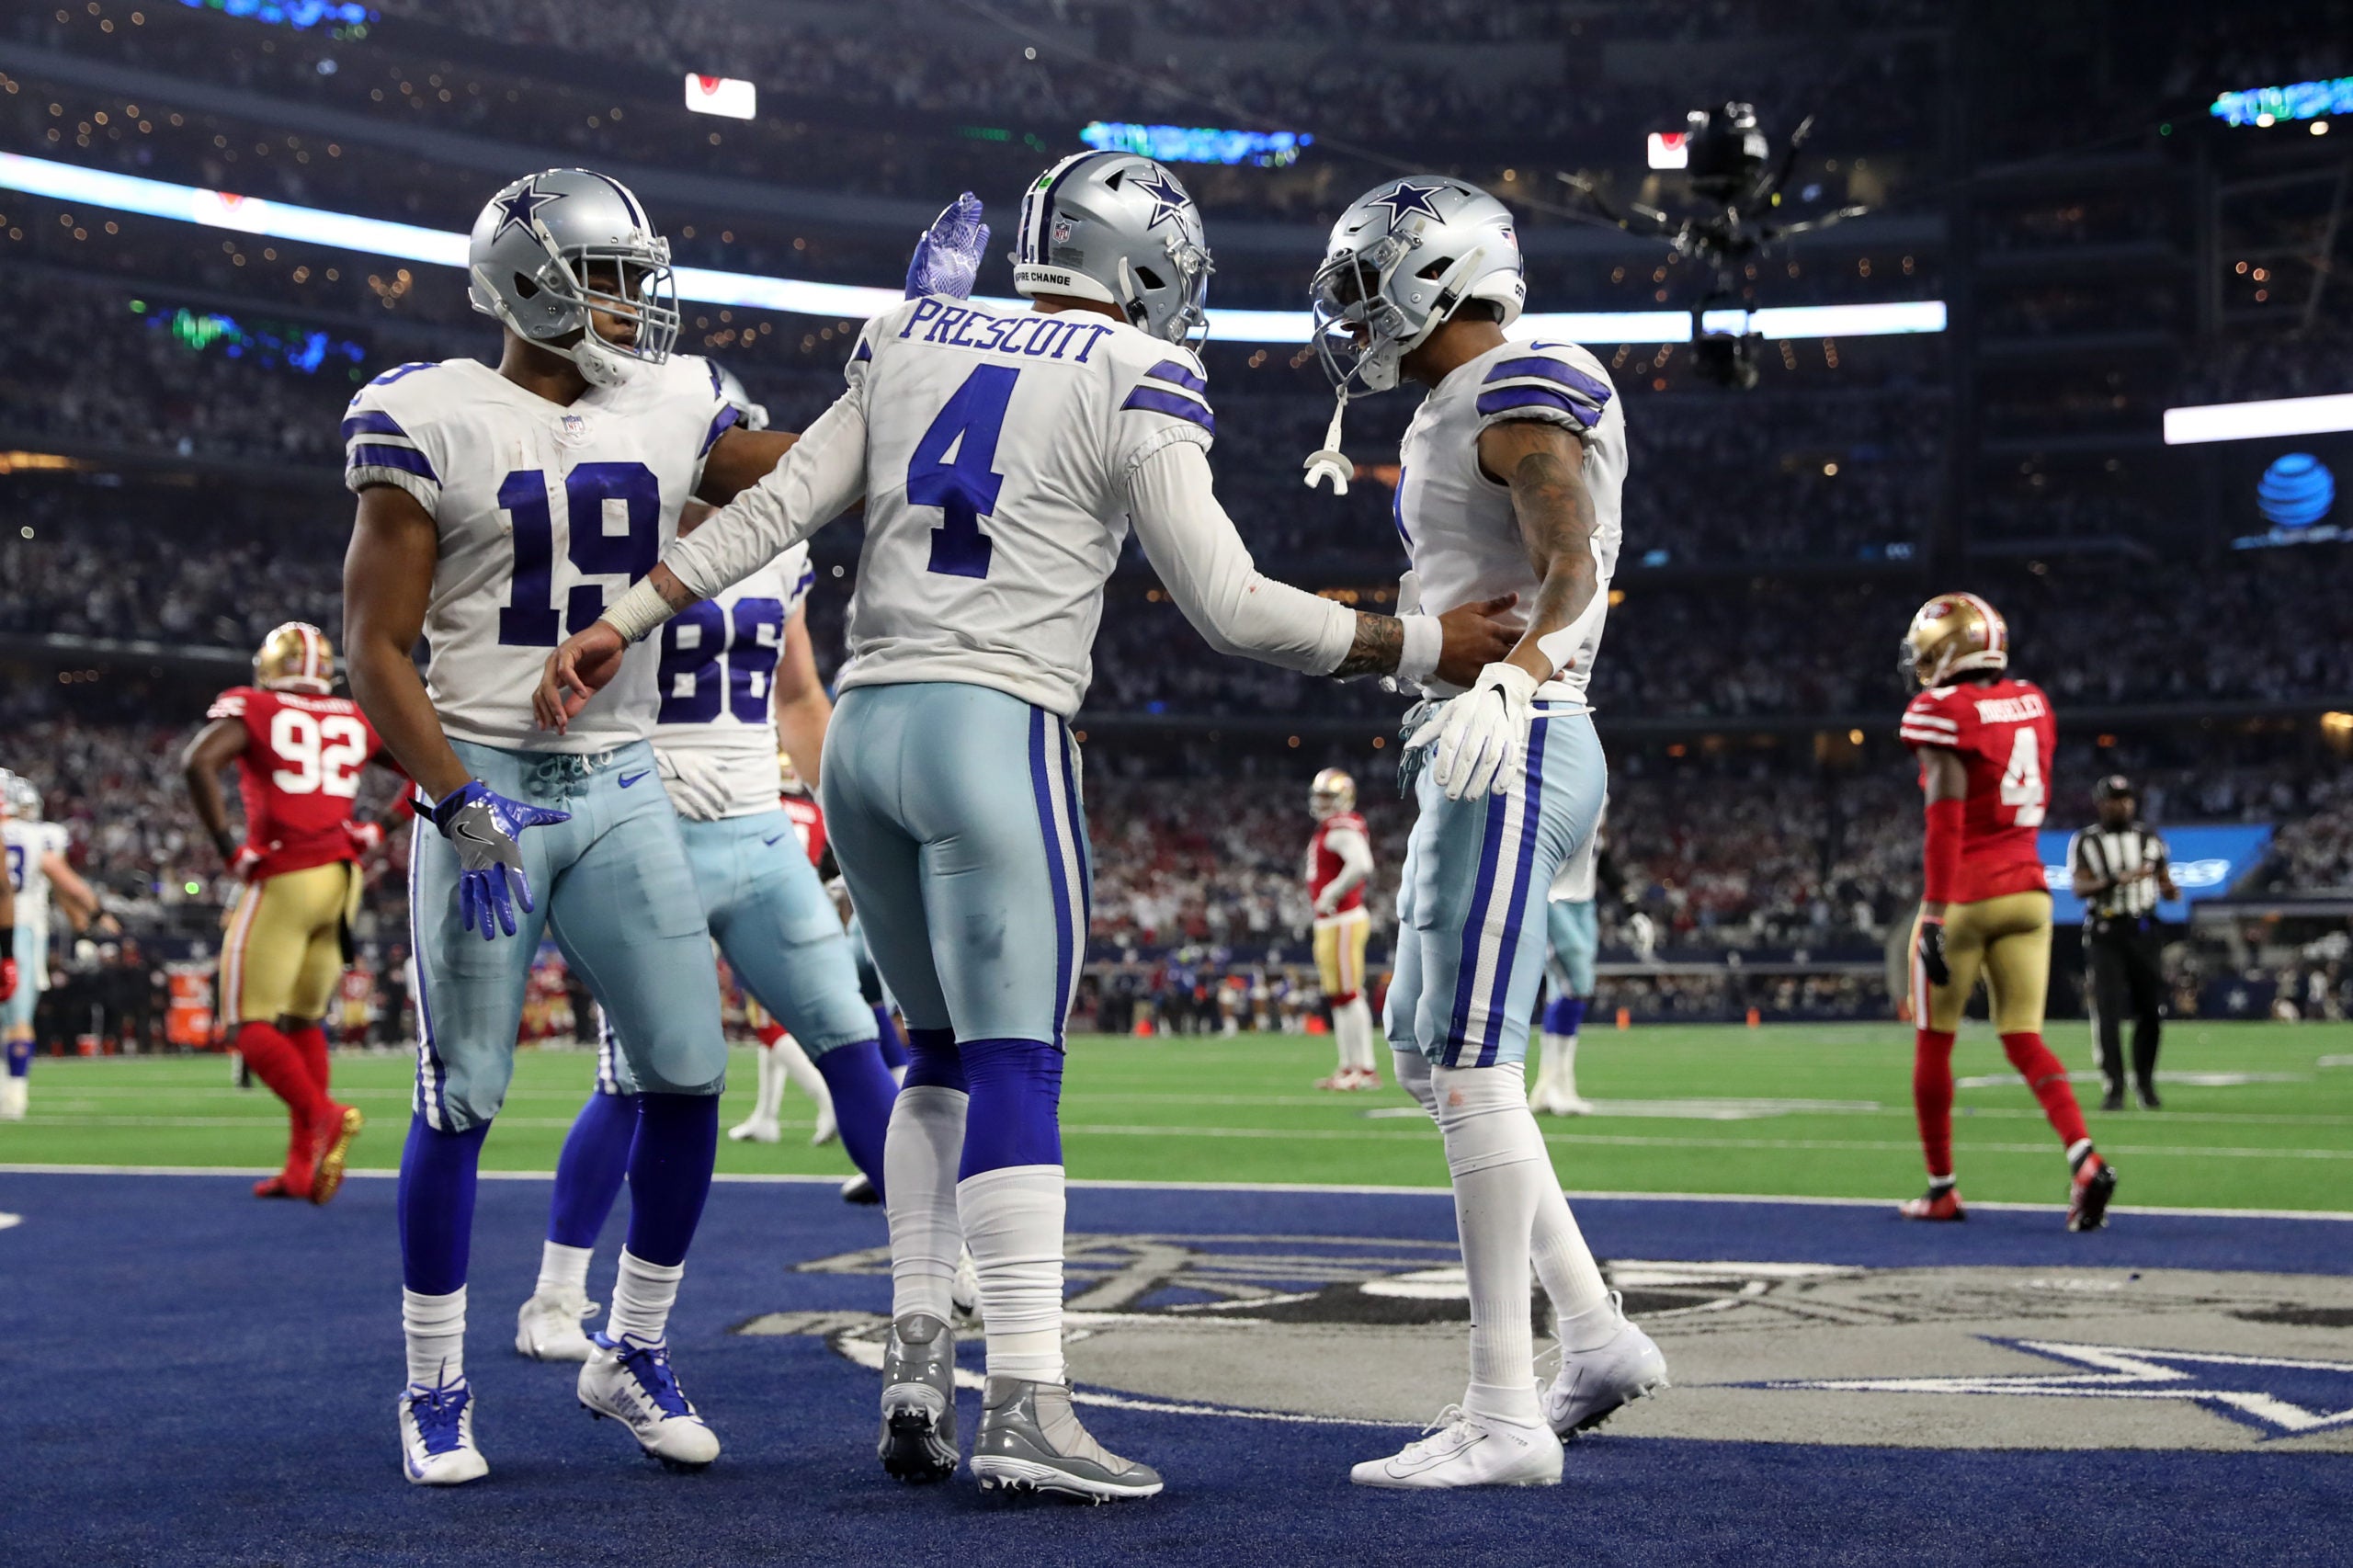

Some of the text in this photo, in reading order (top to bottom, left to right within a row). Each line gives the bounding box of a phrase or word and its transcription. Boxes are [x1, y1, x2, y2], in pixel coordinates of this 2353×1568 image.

[1030, 272, 1071, 286] CHANGE
[899, 297, 1115, 364] PRESCOTT
[906, 363, 1021, 580] 4
[497, 461, 661, 647] 19
[656, 597, 786, 724] 86
[270, 709, 367, 799] 92
[1999, 726, 2046, 827] 4
[907, 1315, 925, 1337] 4
